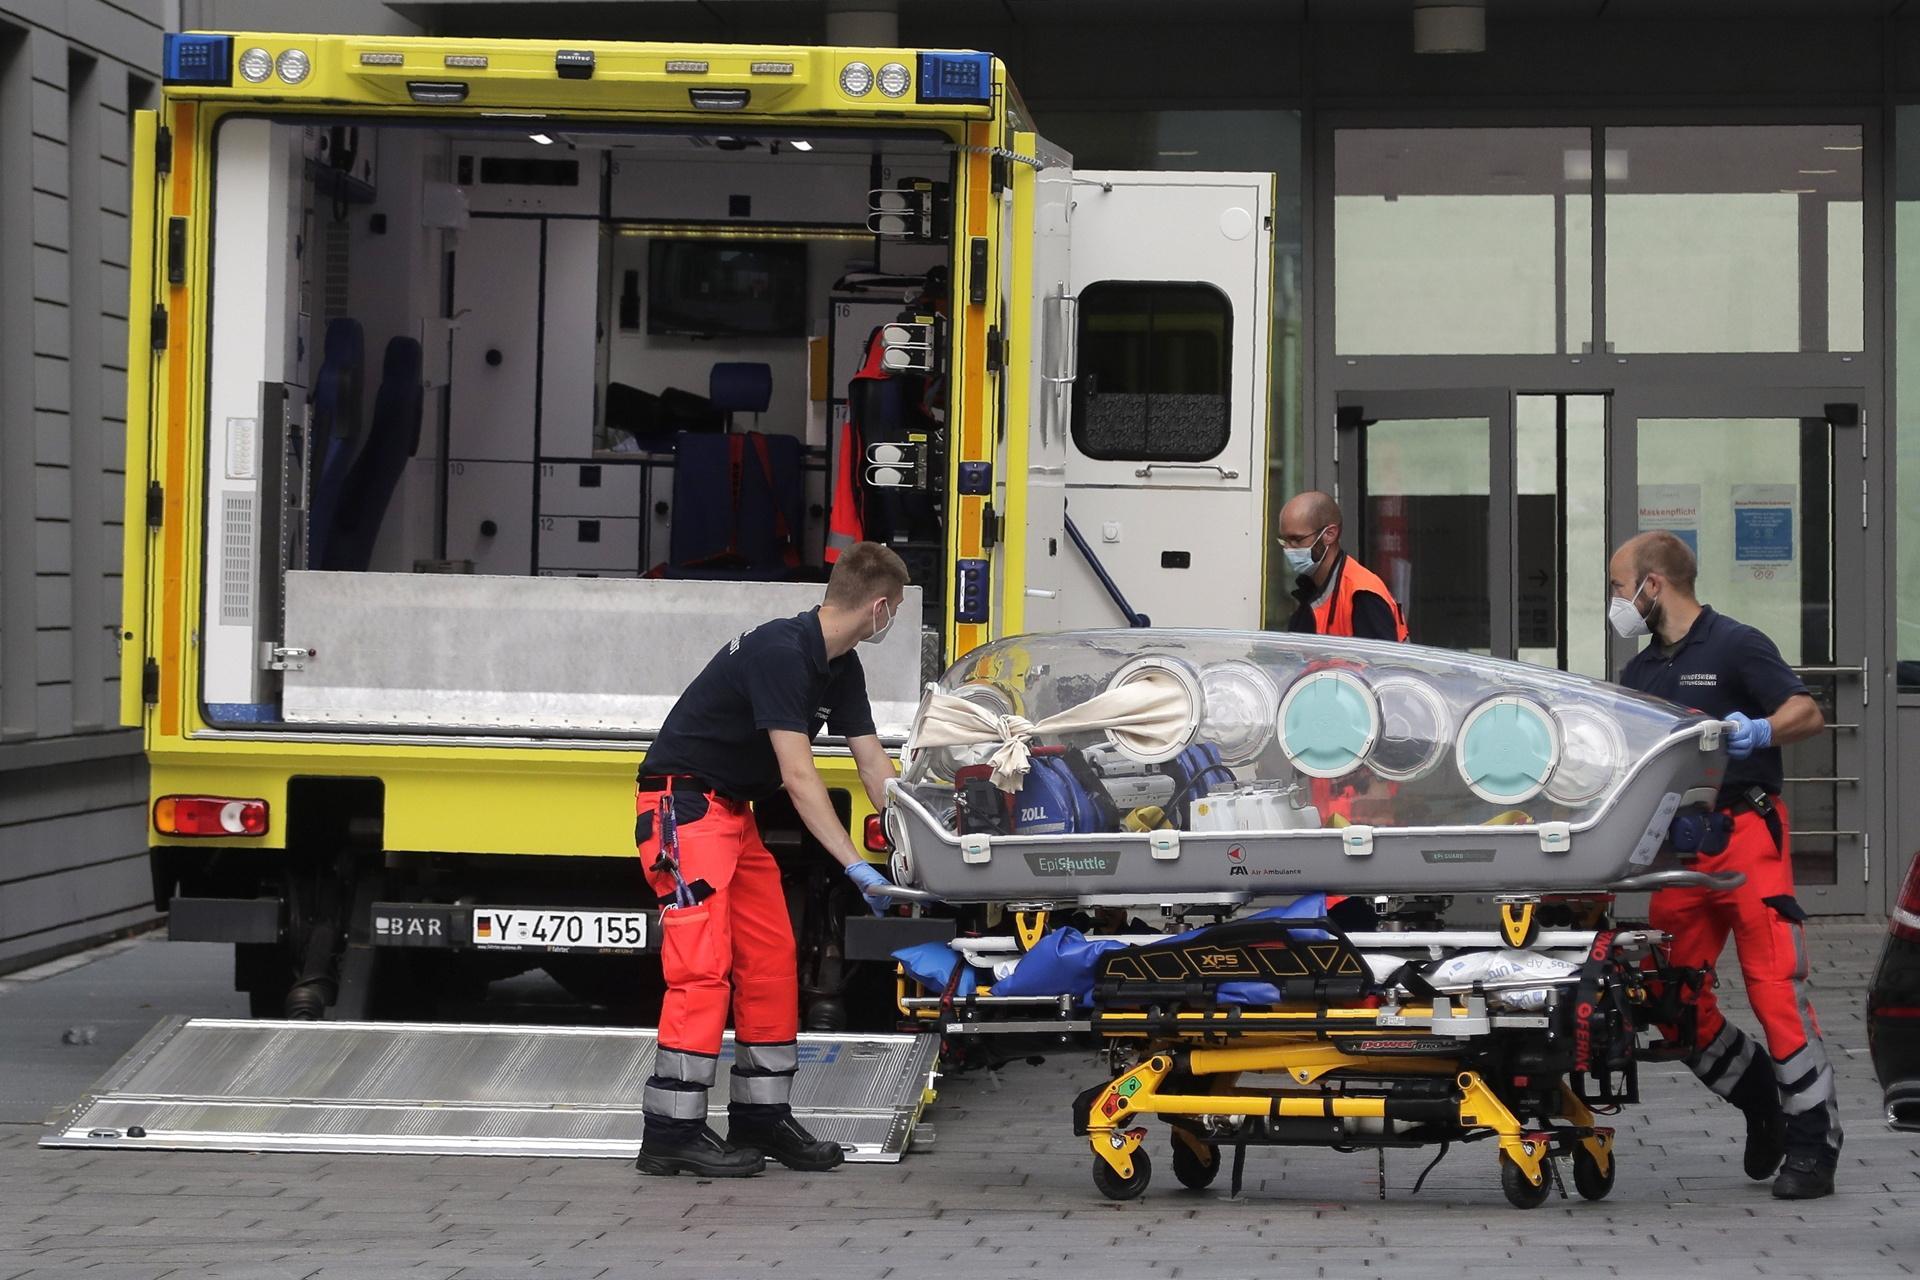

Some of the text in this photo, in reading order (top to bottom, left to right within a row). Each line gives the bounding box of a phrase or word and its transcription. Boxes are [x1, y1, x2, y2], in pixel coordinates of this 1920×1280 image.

[883, 167, 892, 181] 9
[836, 304, 850, 318] 16
[450, 463, 465, 476] 10
[542, 465, 555, 478] 11
[1640, 508, 1696, 517] Maskenpflicht
[541, 518, 554, 531] 12
[1021, 807, 1048, 822] ZOLL
[1038, 856, 1107, 872] EpiShuttle
[1263, 868, 1302, 876] Ambulance
[391, 918, 442, 936] BÄR
[594, 916, 641, 944] 155
[1201, 955, 1239, 965] XPS
